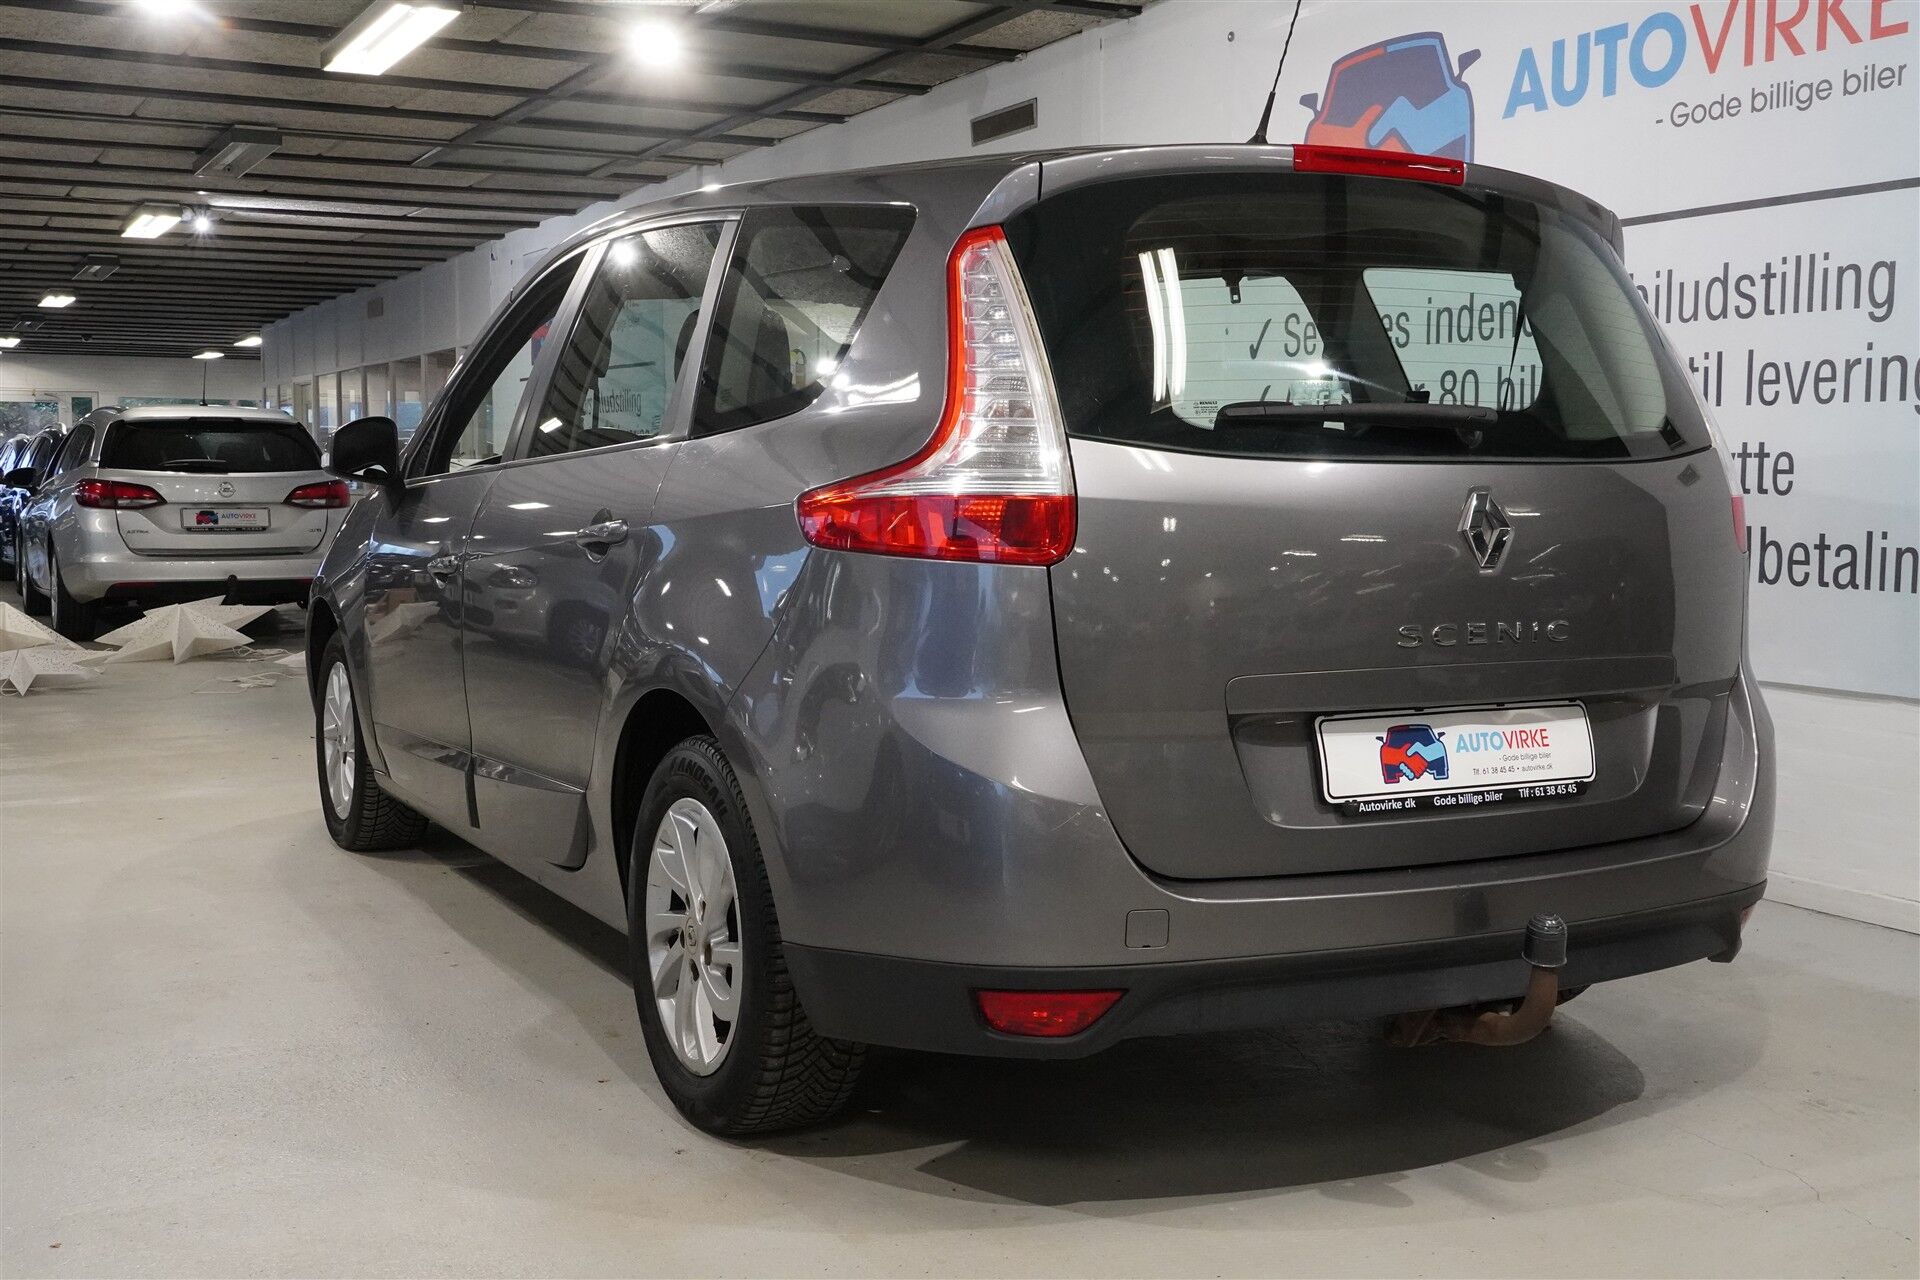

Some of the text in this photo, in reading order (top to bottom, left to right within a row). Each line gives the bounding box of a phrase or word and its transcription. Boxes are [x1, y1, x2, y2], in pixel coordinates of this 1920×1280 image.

[1669, 95, 1742, 128] Gode
[1750, 77, 1833, 114] billige
[1842, 63, 1908, 97] biler
[1283, 312, 1317, 358] Se
[1745, 342, 1920, 415] leverin
[1731, 441, 1795, 496] tte
[1397, 619, 1570, 648] SCENIC
[1455, 728, 1550, 754] AUTOVIRKE
[1482, 767, 1490, 775] 61
[1491, 766, 1499, 774] 38
[1508, 765, 1516, 773] 45
[1521, 763, 1553, 772] autovirke.dk
[1502, 754, 1519, 762] Gode
[1520, 753, 1538, 762] billige
[1359, 799, 1403, 813] Autovirke
[1404, 798, 1417, 808] dk
[1433, 796, 1457, 806] Gode
[1458, 793, 1483, 805] billige
[1484, 791, 1504, 802] biler
[1535, 788, 1544, 797] 61
[1546, 786, 1556, 796] 38
[1557, 785, 1566, 794] 45
[1568, 784, 1577, 793] 45
